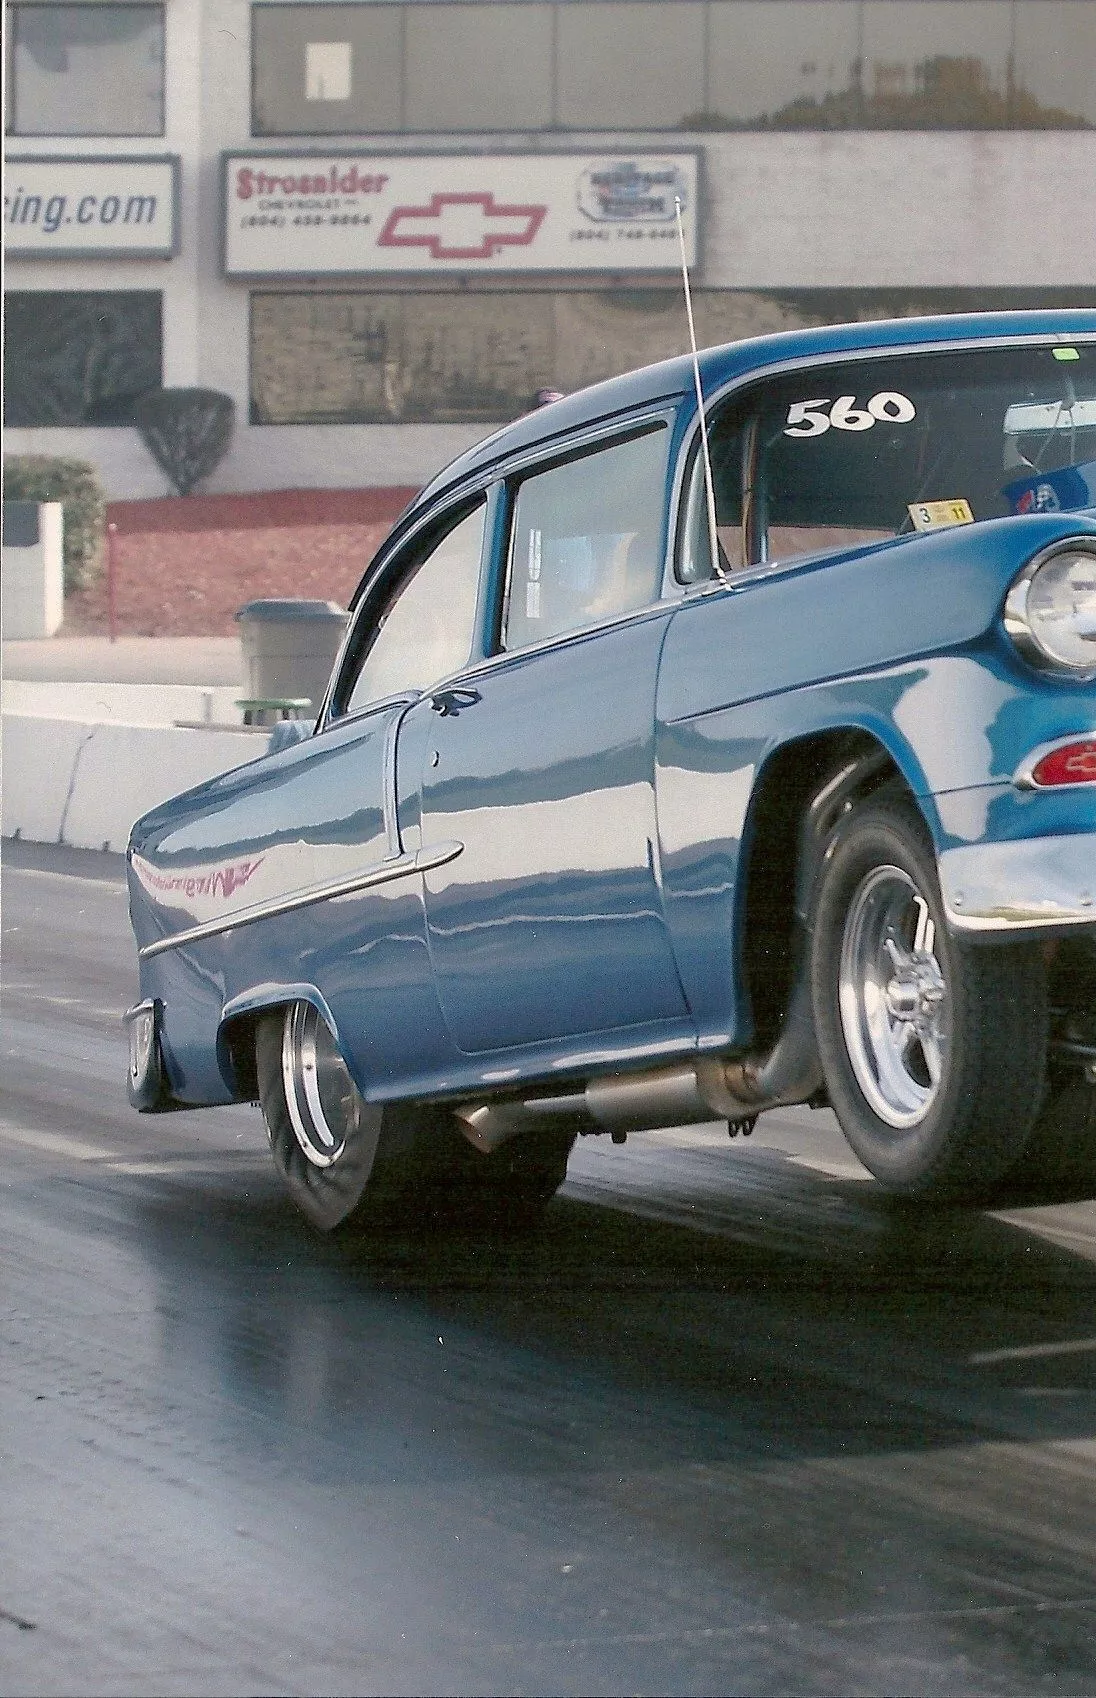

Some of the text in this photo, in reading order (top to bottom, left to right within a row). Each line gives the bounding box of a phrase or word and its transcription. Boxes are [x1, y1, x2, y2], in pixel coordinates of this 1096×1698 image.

[783, 391, 916, 438] 560
[919, 508, 931, 523] 3
[951, 506, 967, 520] 11
